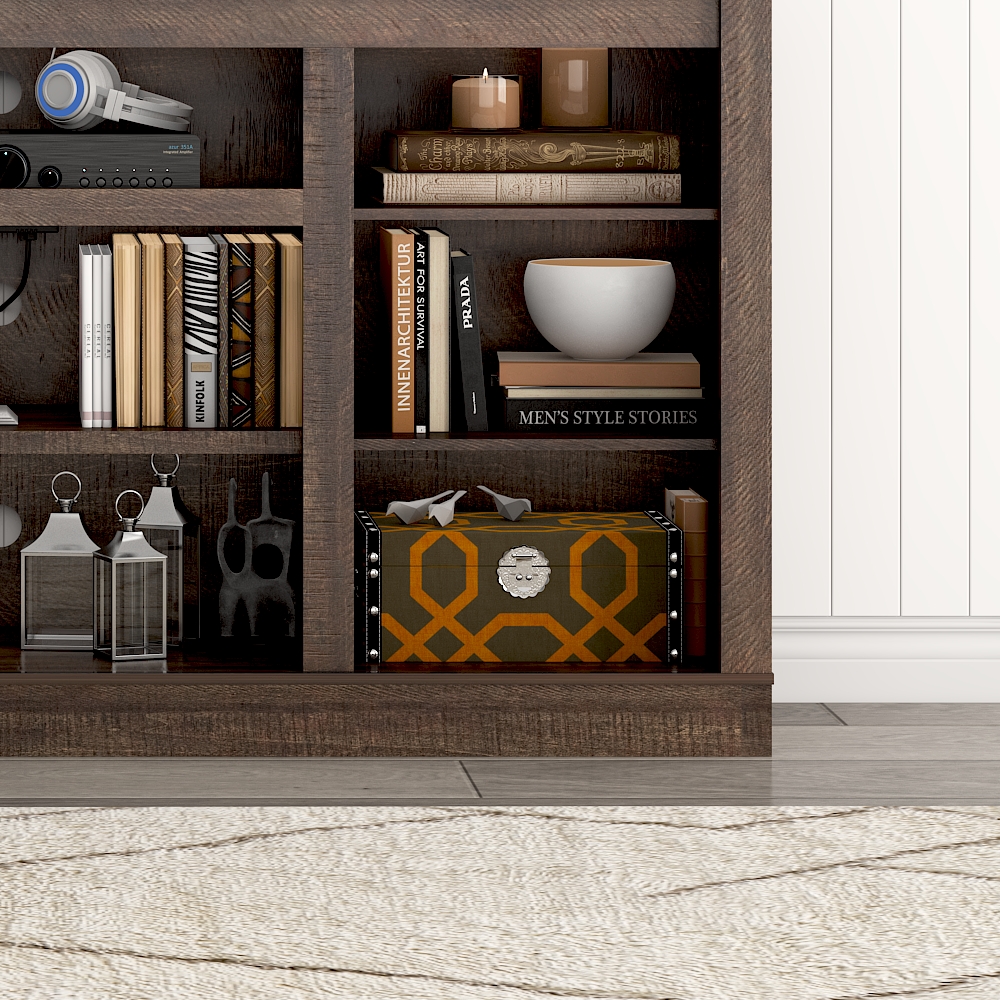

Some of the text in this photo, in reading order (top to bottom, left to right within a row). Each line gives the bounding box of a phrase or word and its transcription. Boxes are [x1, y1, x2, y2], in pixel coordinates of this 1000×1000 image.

[428, 137, 443, 170] Charm
[461, 143, 477, 165] Plays
[416, 242, 426, 350] ART FOR SURVIVAL
[460, 276, 473, 329] PRADA
[397, 243, 411, 412] INNENARCHITEKTUR
[195, 380, 205, 423] KINFOLK
[518, 410, 698, 425] MEN'S STYLE STORIES
